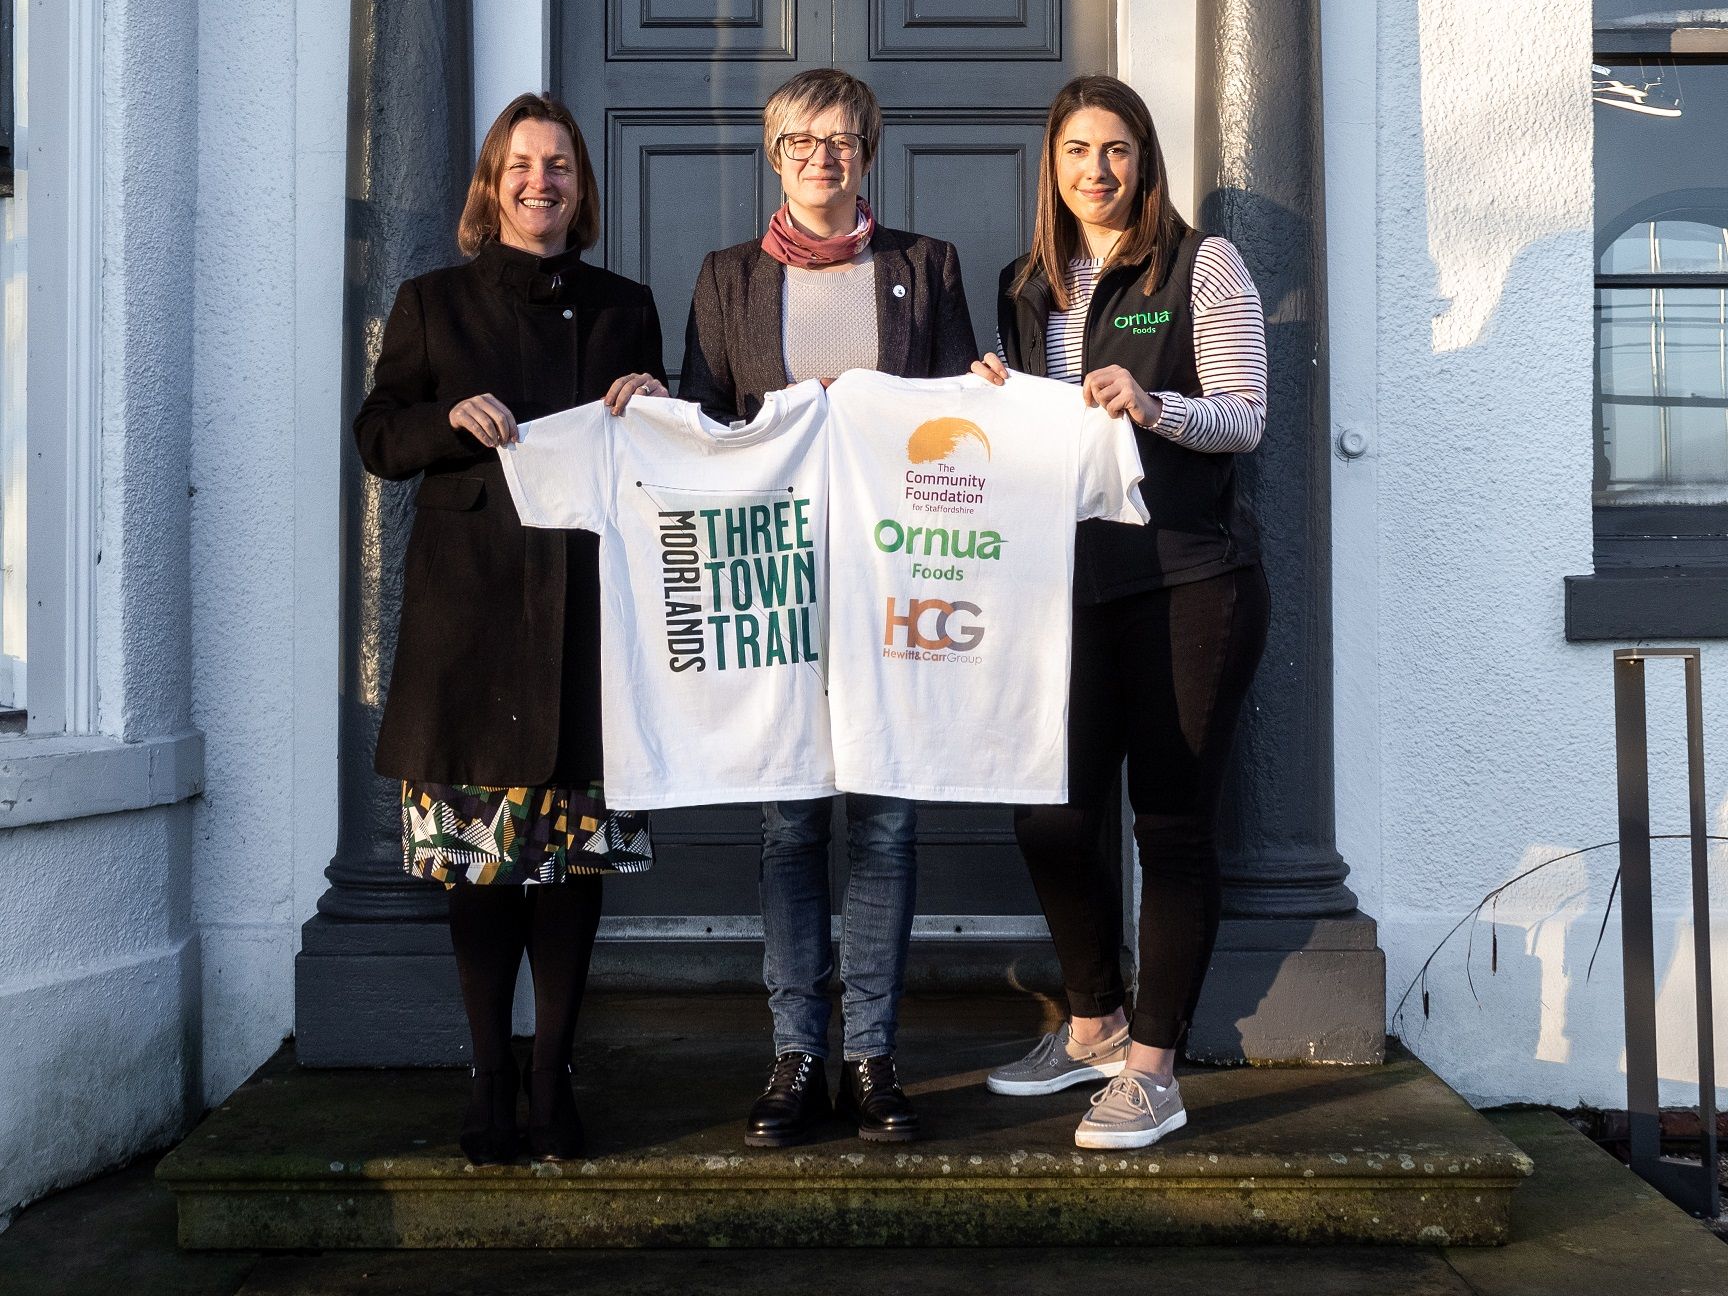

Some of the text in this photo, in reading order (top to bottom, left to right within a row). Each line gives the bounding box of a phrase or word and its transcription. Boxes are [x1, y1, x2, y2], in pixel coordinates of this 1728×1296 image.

[1132, 327, 1156, 335] Foods
[905, 470, 986, 491] Community
[938, 463, 955, 473] The
[905, 487, 984, 504] Foundation
[925, 505, 975, 515] Staffordshire
[700, 498, 814, 559] THREE
[874, 519, 1008, 560] Ornua
[704, 550, 817, 613] TOWN
[912, 563, 964, 581] Foods
[658, 510, 706, 673] MOORLANDS
[707, 606, 819, 671] TRAIL
[884, 596, 986, 652] HCG
